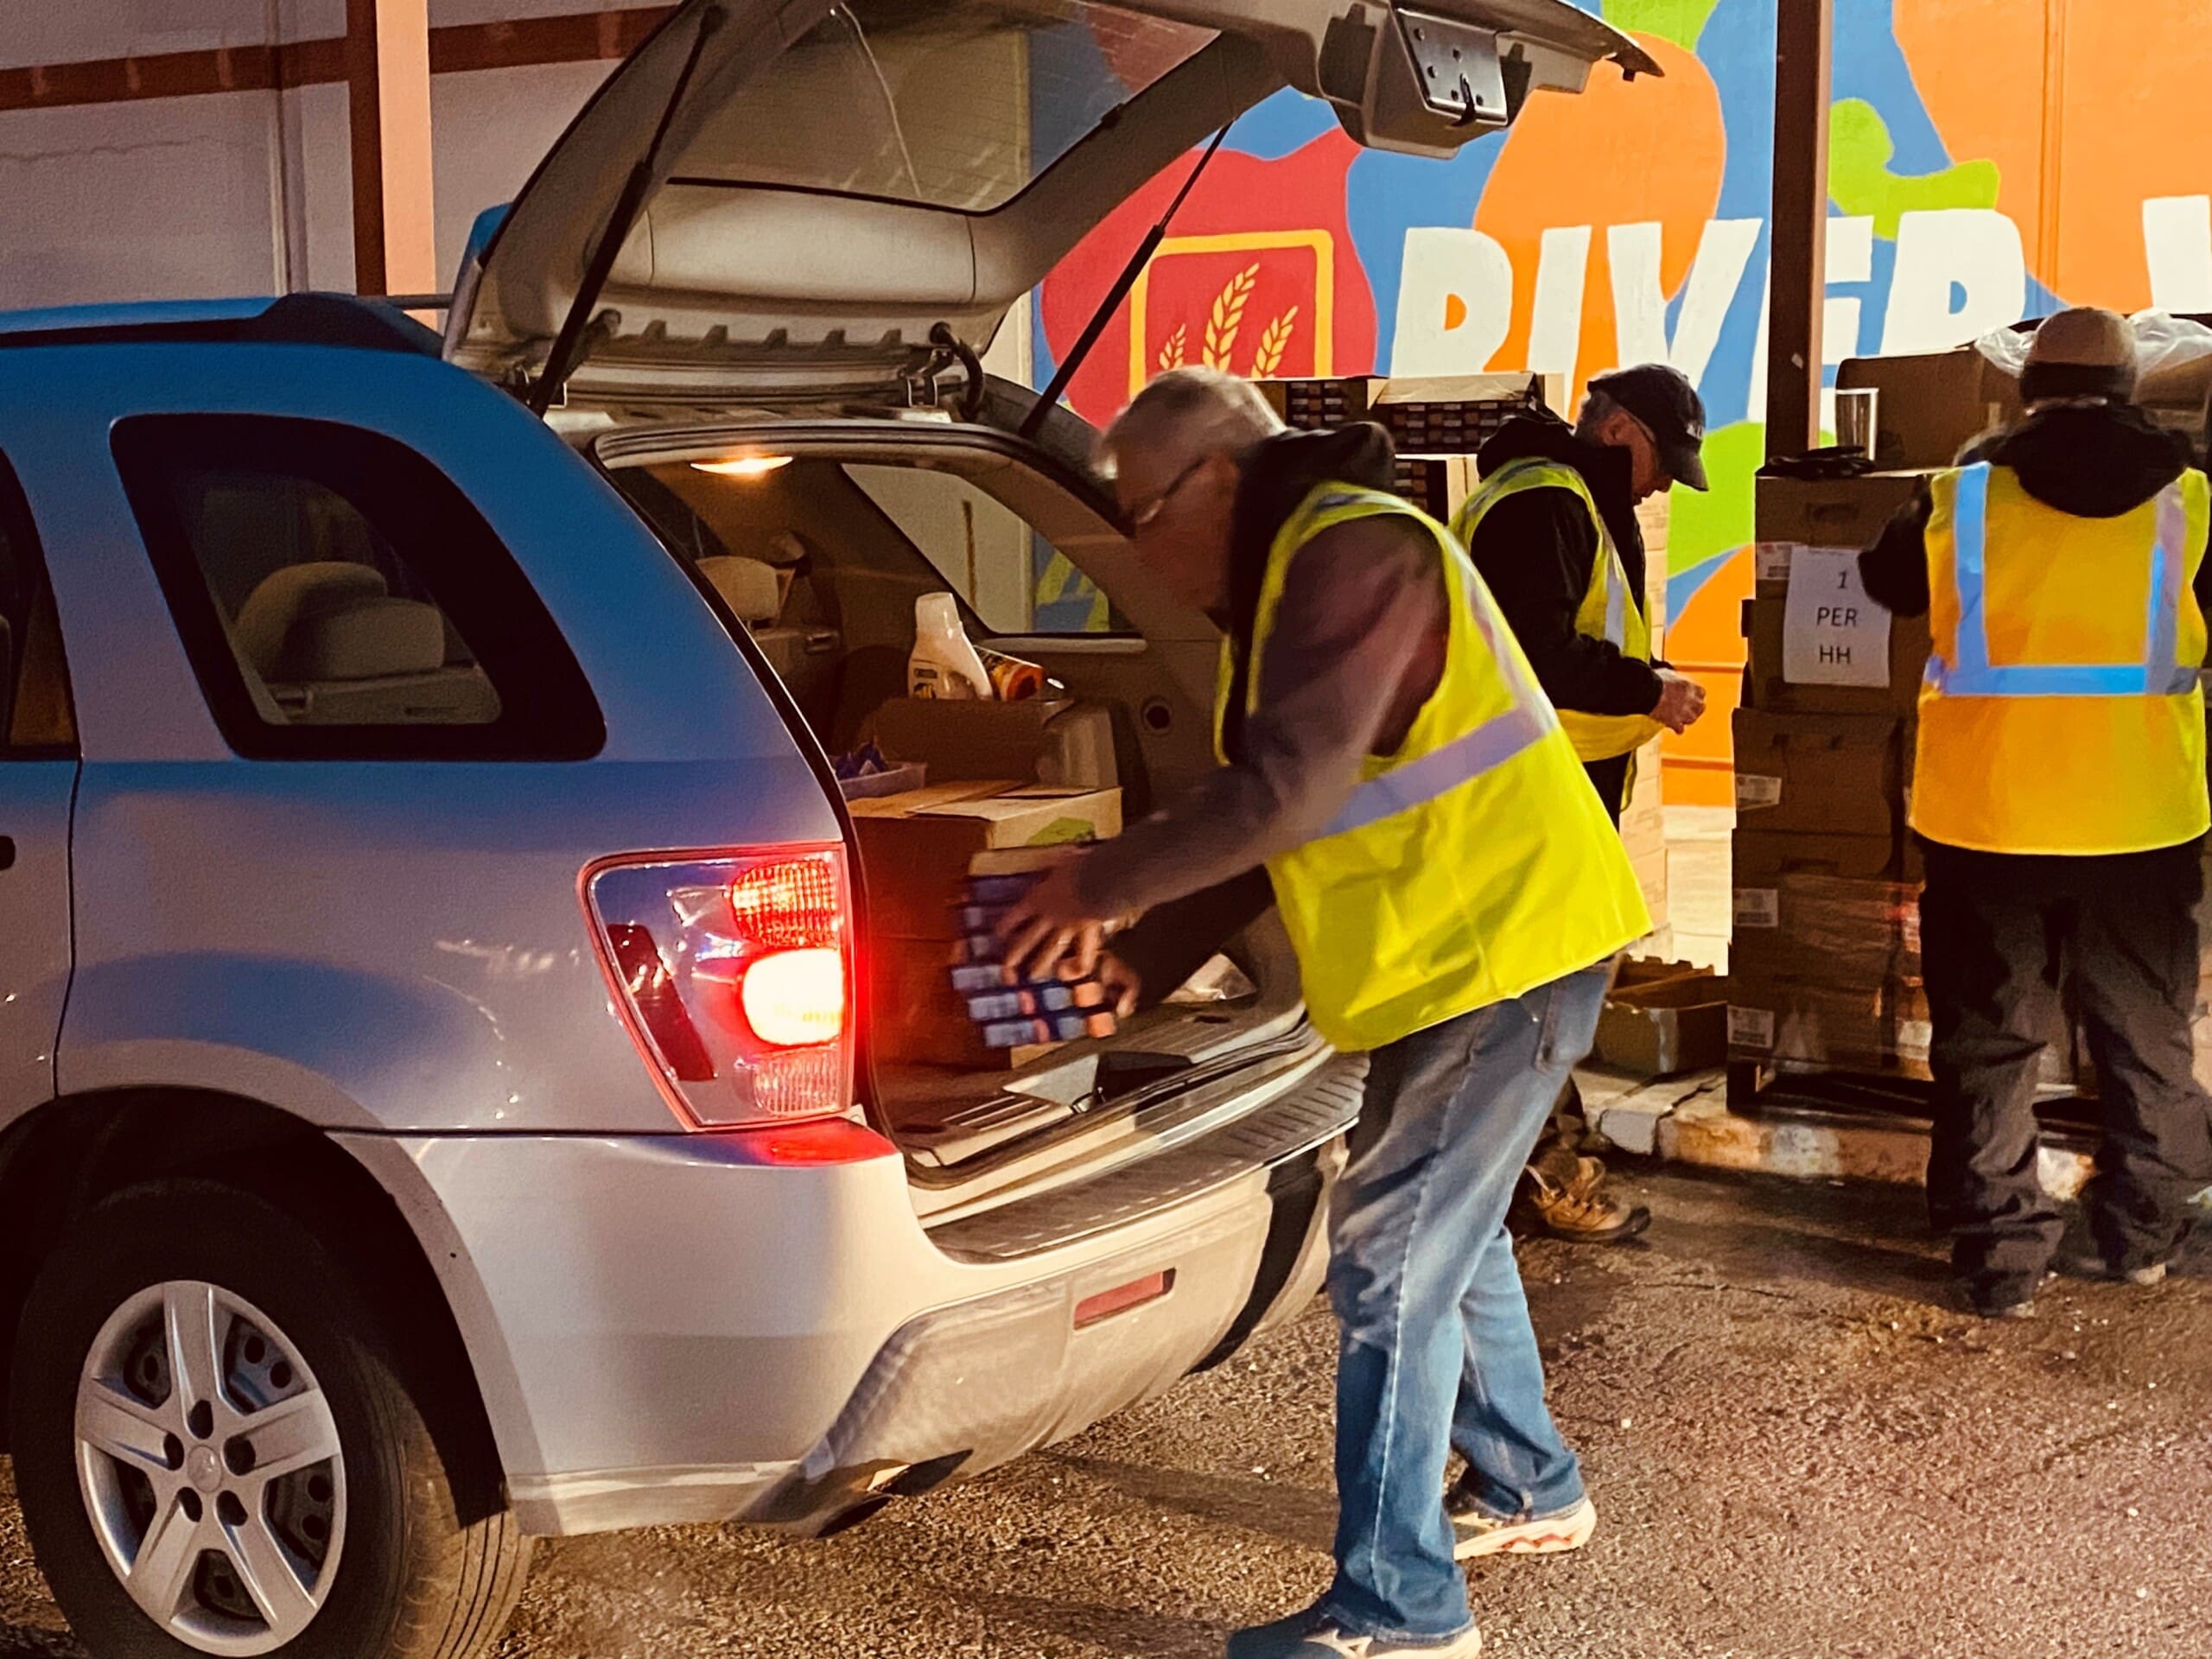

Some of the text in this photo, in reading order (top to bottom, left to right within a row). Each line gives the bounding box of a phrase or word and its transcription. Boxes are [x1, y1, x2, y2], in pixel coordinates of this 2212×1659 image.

[1837, 571, 1847, 589] 1
[1816, 607, 1857, 626] PER
[1819, 645, 1852, 664] HH
